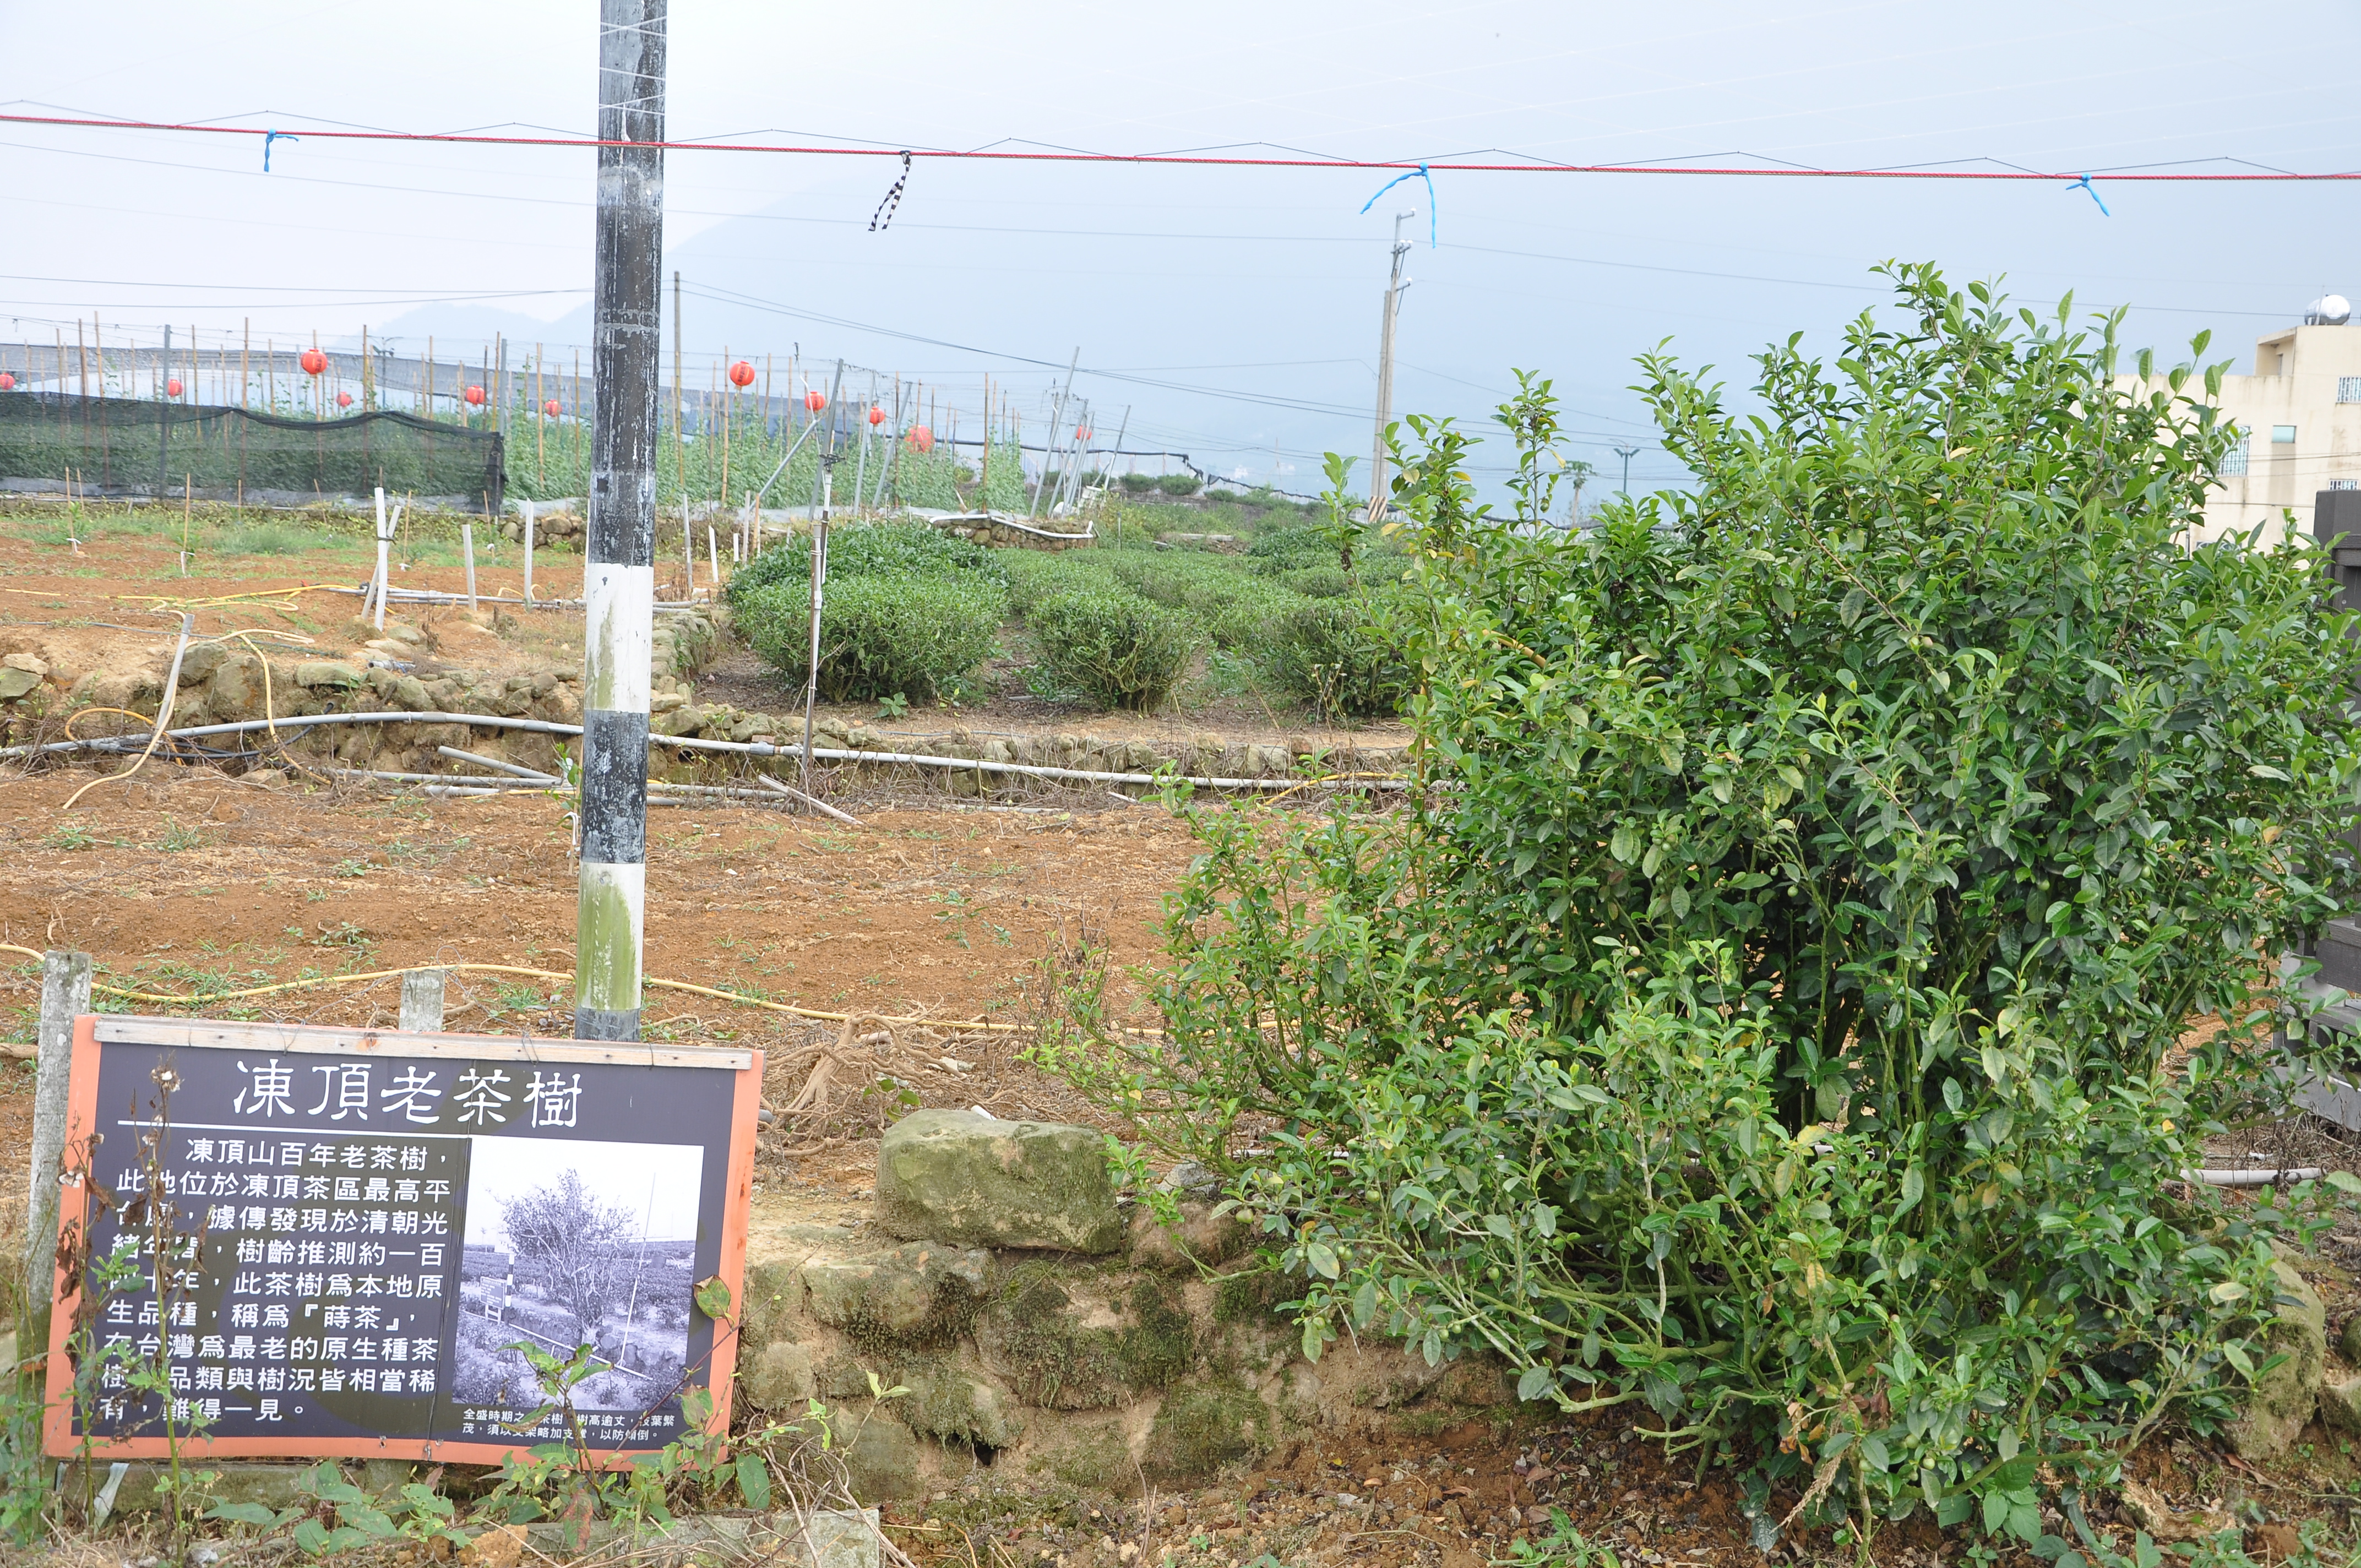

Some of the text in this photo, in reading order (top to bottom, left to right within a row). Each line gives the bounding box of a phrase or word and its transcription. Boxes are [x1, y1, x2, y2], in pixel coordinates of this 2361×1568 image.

[233, 1058, 582, 1128] 凍頂老茶樹
[186, 1137, 446, 1171] 凍頂山百年老茶樹，
[116, 1168, 450, 1204] 此地位於凍頂茶區最高平
[110, 1268, 443, 1298] 十年，此茶樹爲本地原
[101, 1363, 436, 1392] 樹品類與樹況皆相當稀
